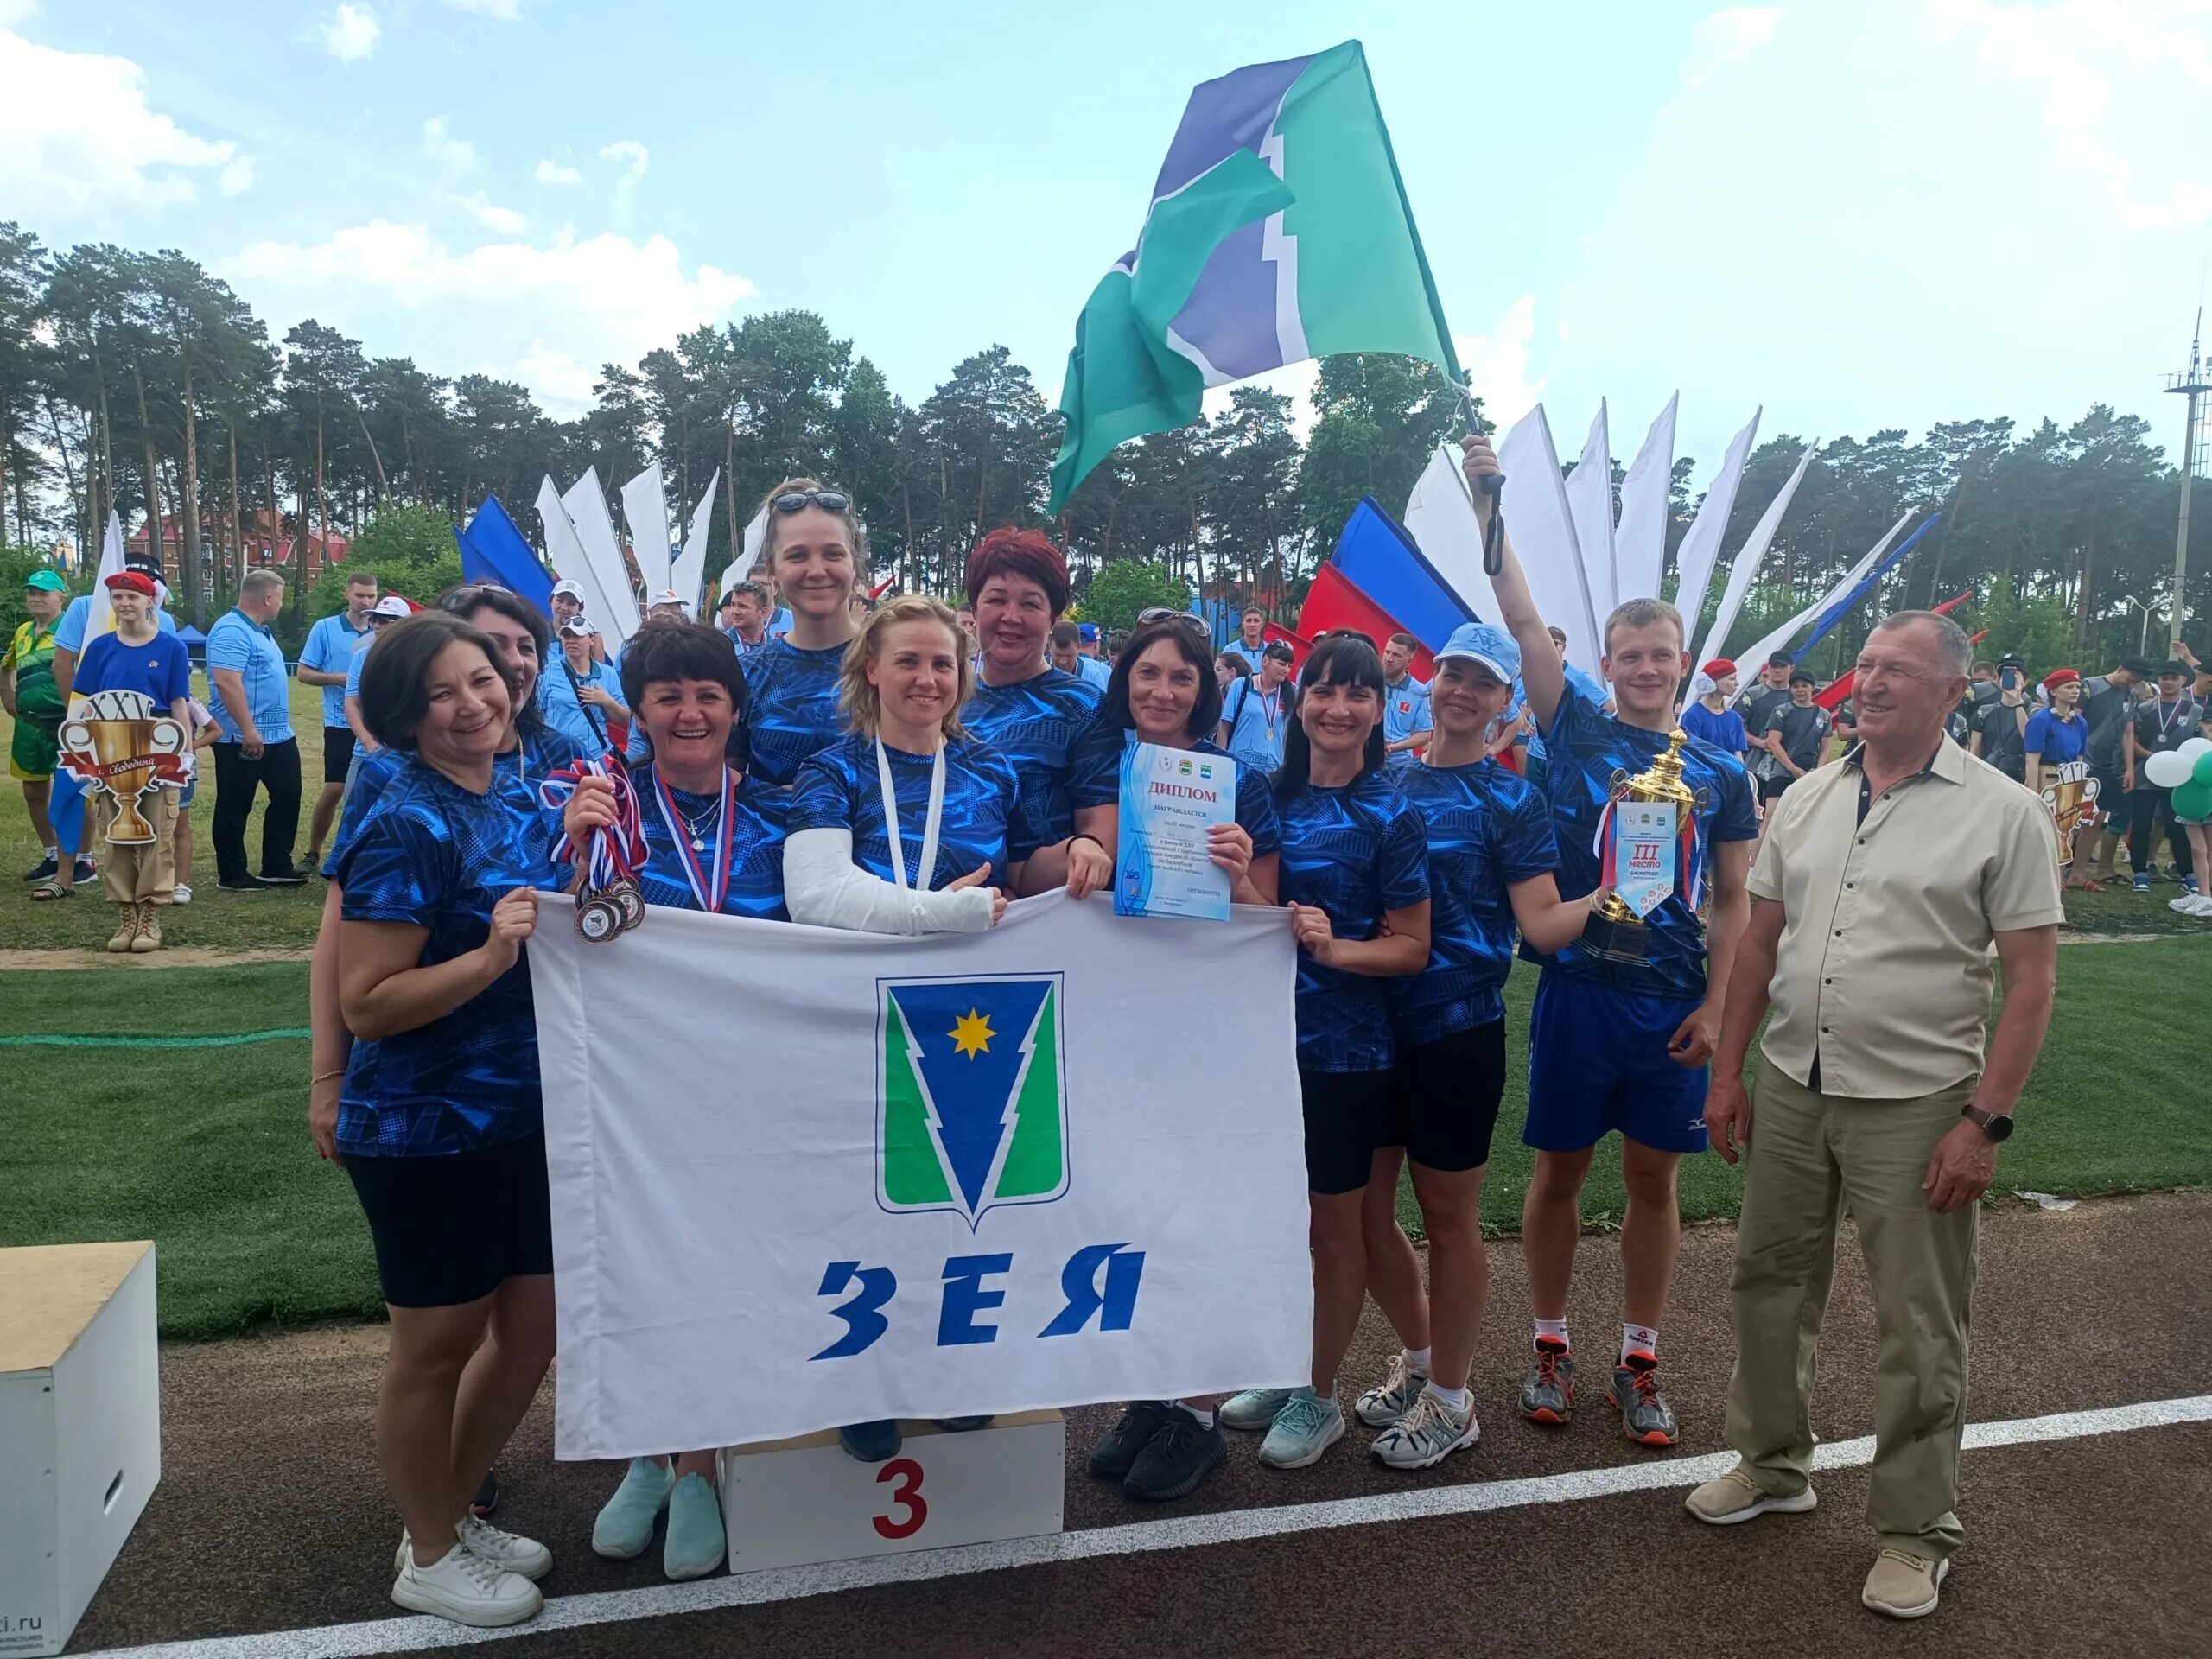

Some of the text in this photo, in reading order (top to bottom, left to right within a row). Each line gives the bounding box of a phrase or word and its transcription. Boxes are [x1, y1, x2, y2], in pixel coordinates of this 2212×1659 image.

[109, 757, 156, 775] Свободный
[1148, 781, 1217, 804] ДИПЛОМ
[1154, 804, 1207, 817] НАГРАЖДАЕТСЯ
[1632, 844, 1660, 861] III
[806, 1242, 1147, 1362] ЗЕЯ
[872, 1458, 928, 1540] 3
